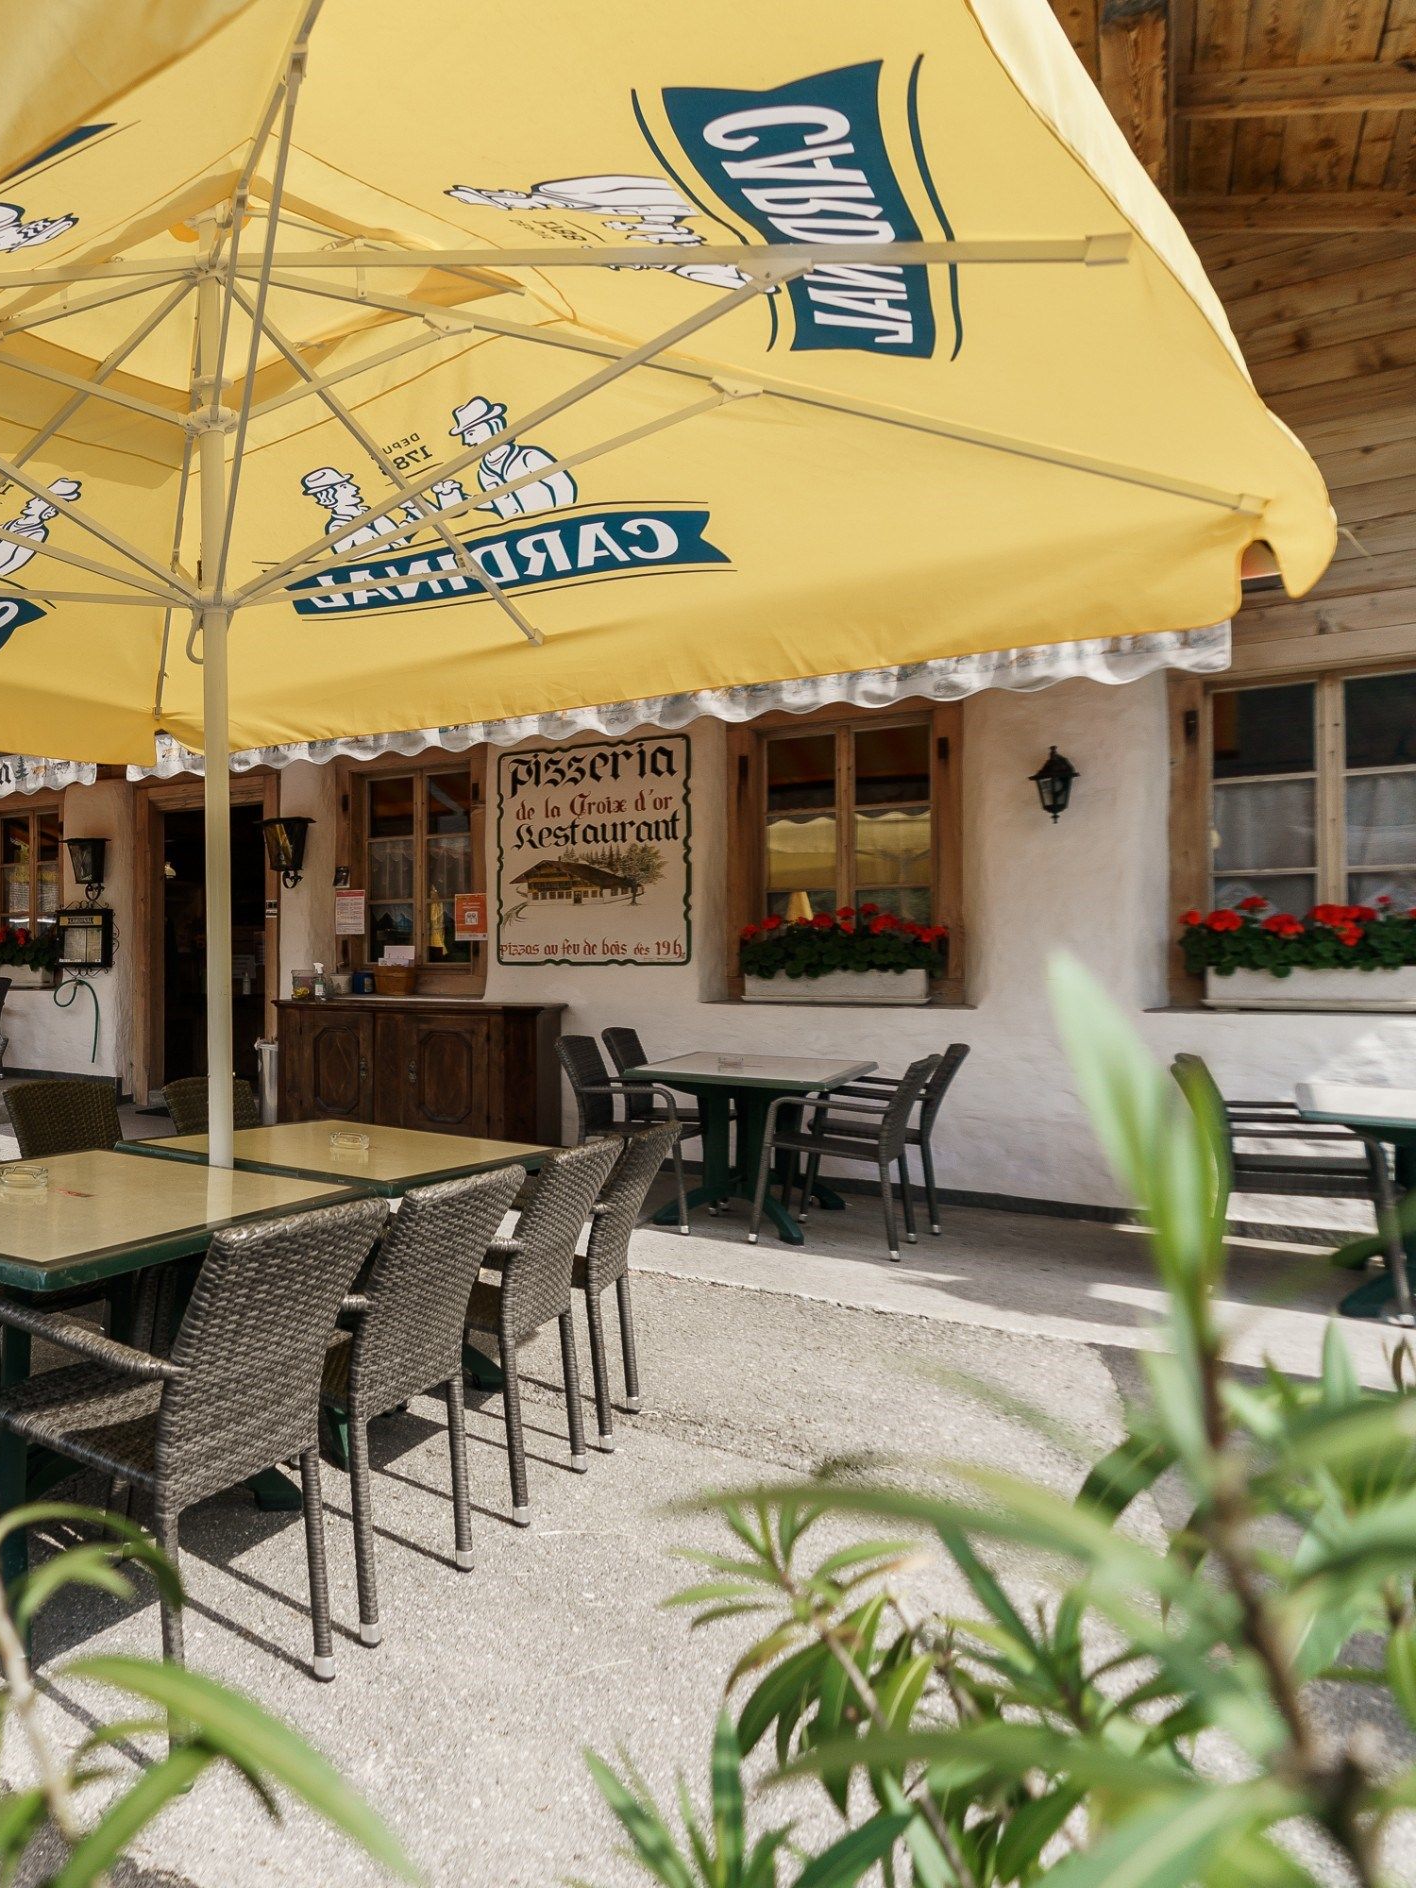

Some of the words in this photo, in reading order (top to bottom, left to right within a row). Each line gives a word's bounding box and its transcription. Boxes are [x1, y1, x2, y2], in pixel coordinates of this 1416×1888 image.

[516, 801, 535, 821] de
[545, 796, 561, 819] la
[570, 791, 627, 819] Croix
[635, 788, 674, 812] d'or
[512, 809, 681, 850] Restaurant
[544, 941, 559, 956] au
[562, 938, 580, 957] feu
[583, 938, 598, 956] de
[601, 937, 628, 956] bois
